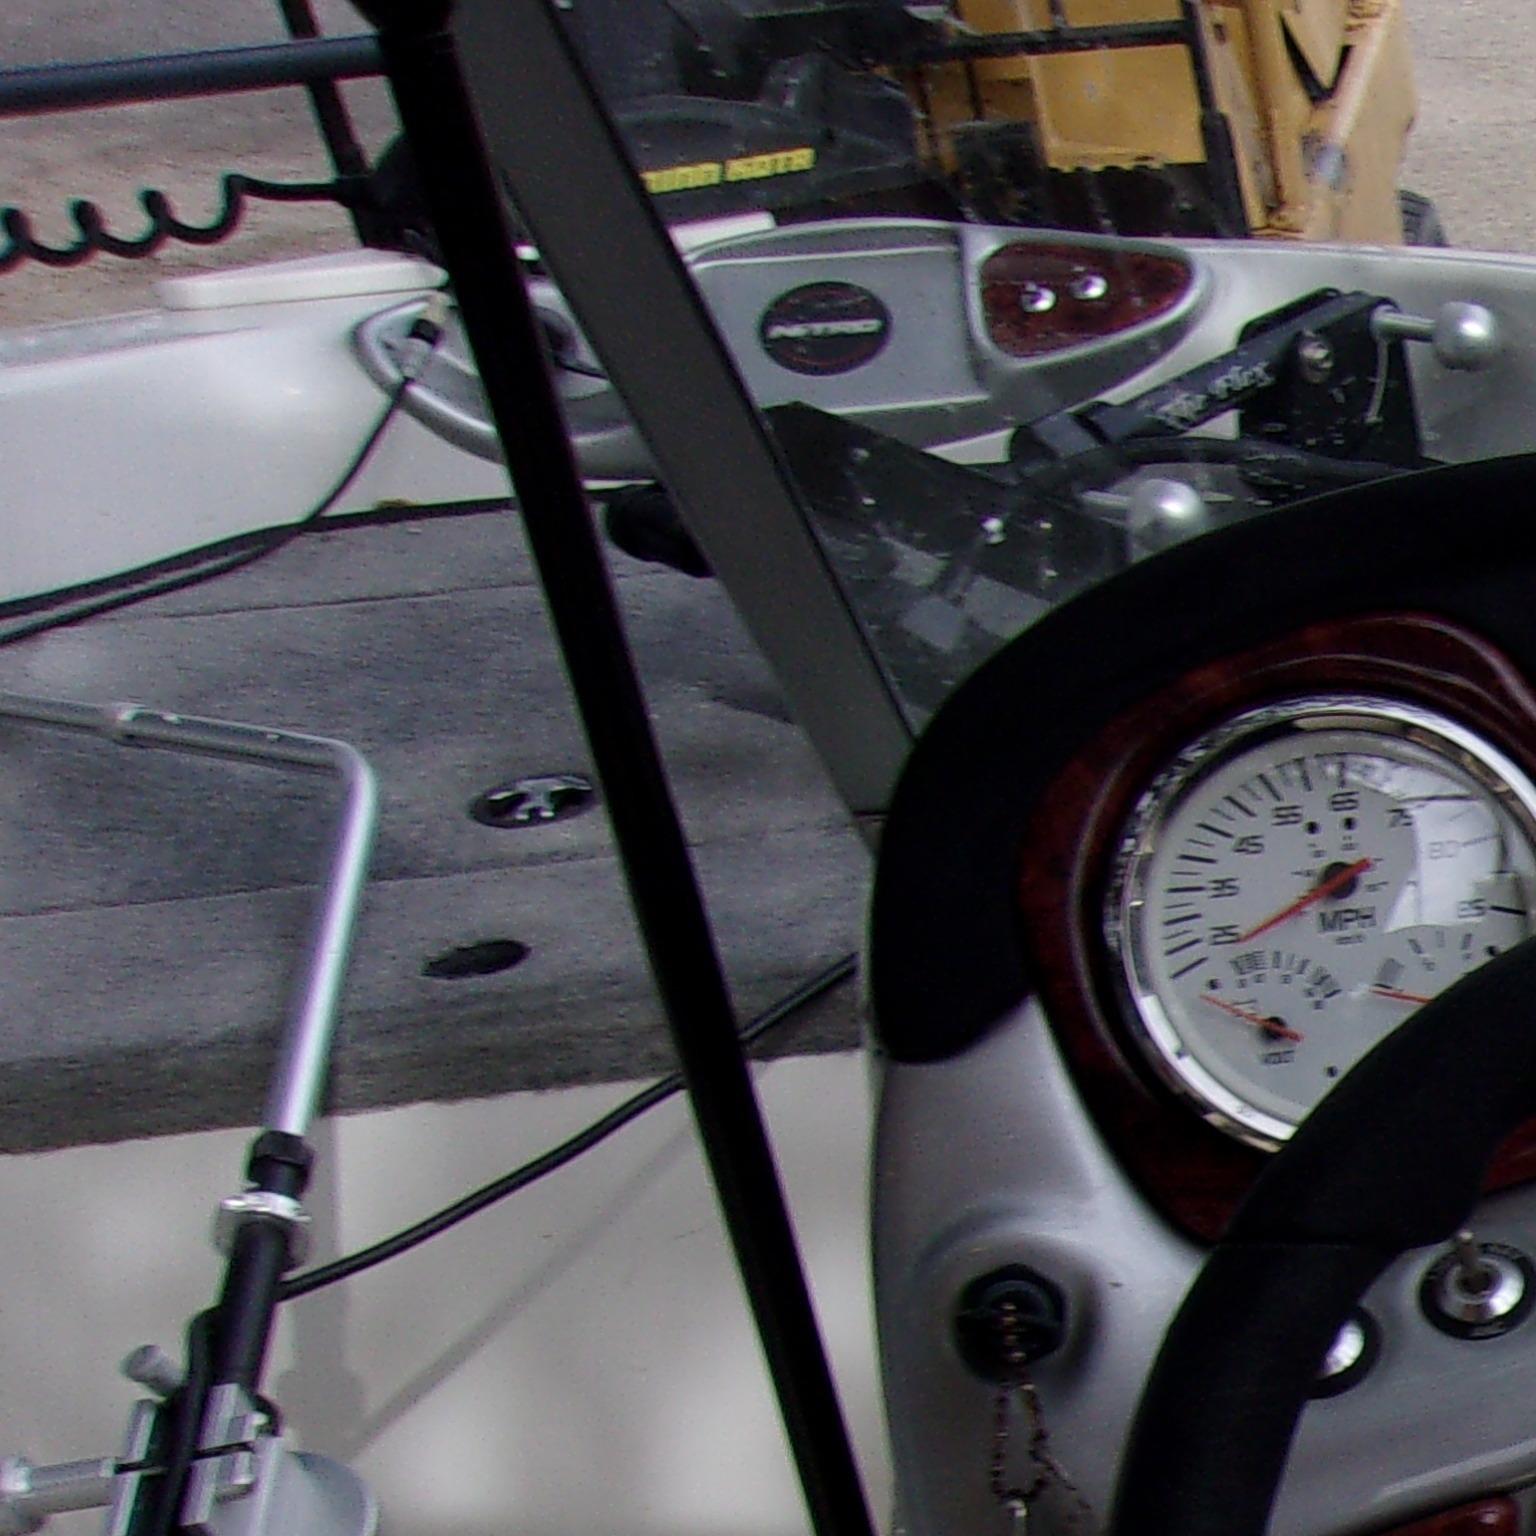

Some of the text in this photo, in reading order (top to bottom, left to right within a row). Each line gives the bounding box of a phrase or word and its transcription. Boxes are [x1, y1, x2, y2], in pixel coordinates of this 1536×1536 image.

[1386, 807, 1414, 829] 75
[1232, 834, 1265, 855] 45
[1208, 878, 1240, 899] 35
[1317, 905, 1377, 934] MPH
